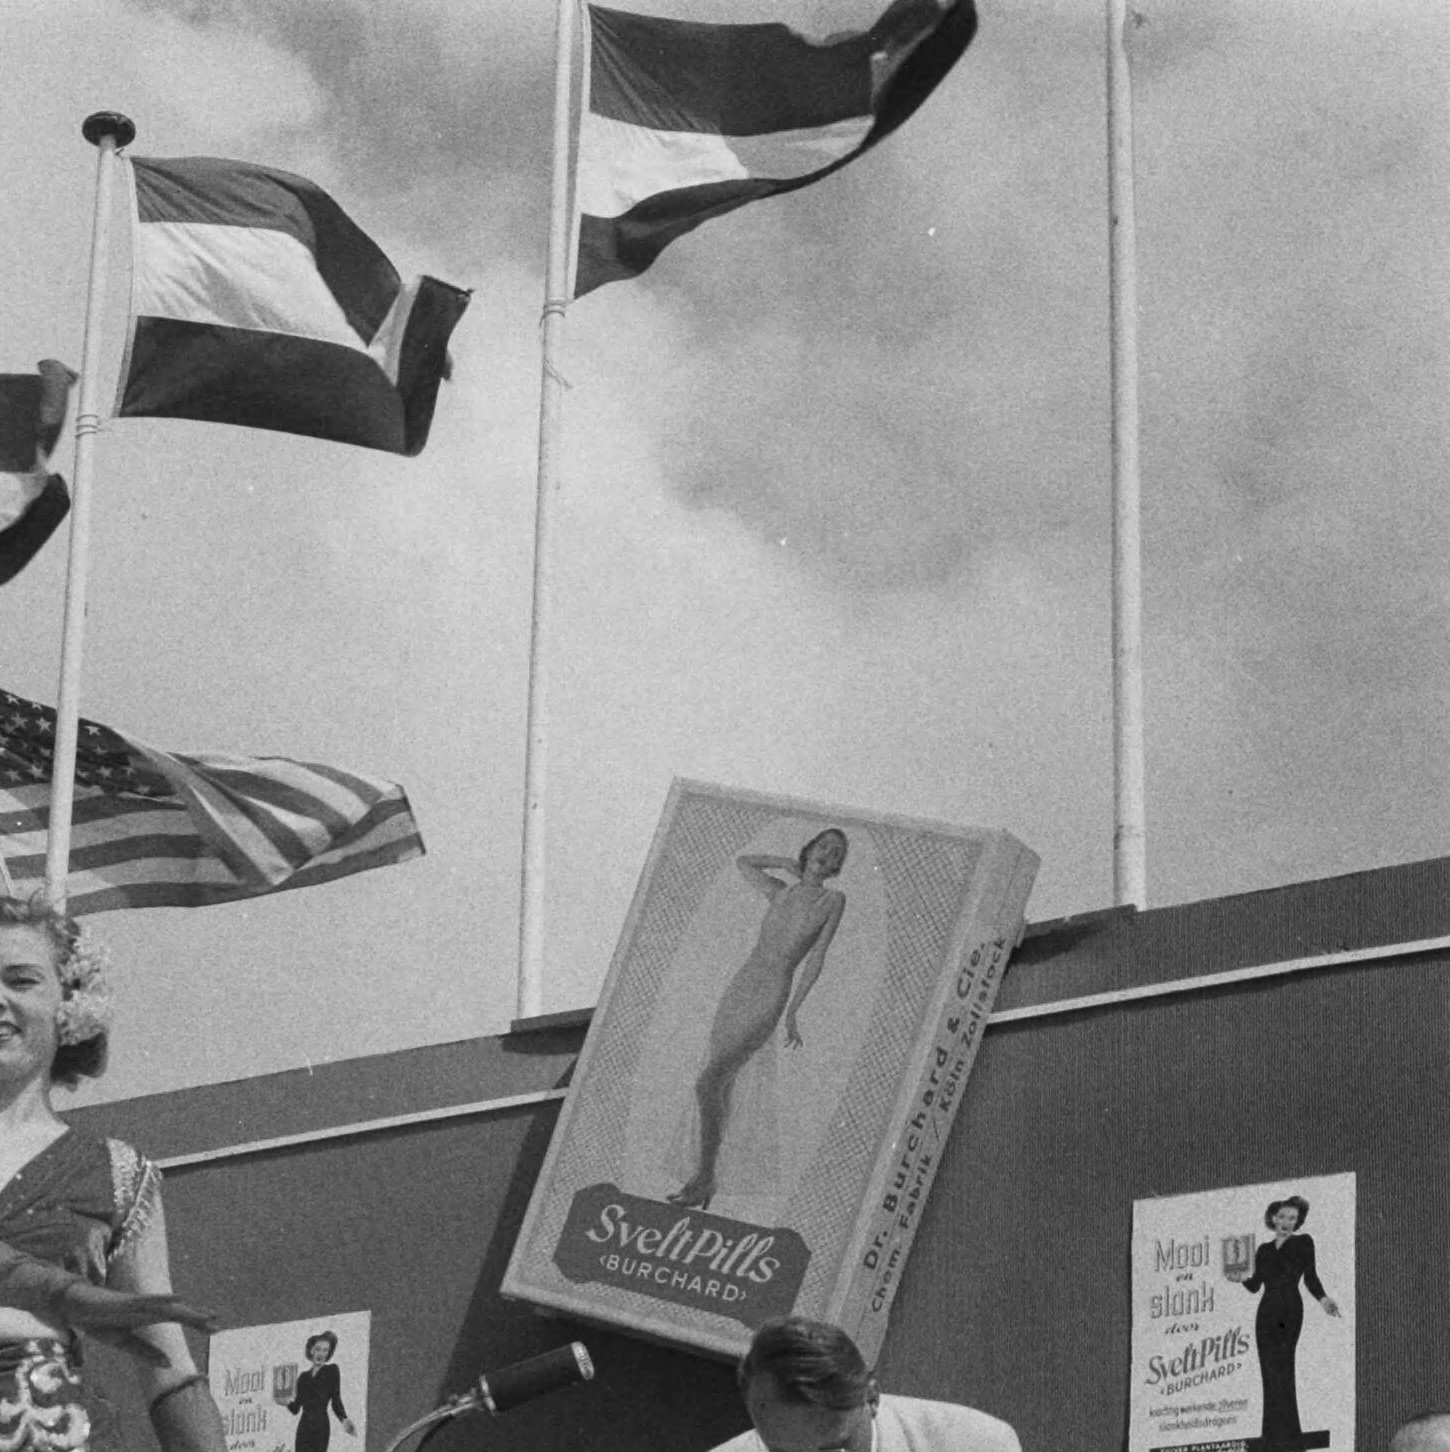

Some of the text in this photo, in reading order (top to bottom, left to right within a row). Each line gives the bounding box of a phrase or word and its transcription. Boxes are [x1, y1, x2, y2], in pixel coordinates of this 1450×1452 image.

[899, 1154, 932, 1229] Fabrik
[962, 937, 1006, 1048] Zollstock
[863, 942, 987, 1270] Dr. Burchard & Cie.
[1154, 1235, 1210, 1273] Mooi
[1151, 1280, 1215, 1319] slank
[225, 1364, 264, 1396] Mooi
